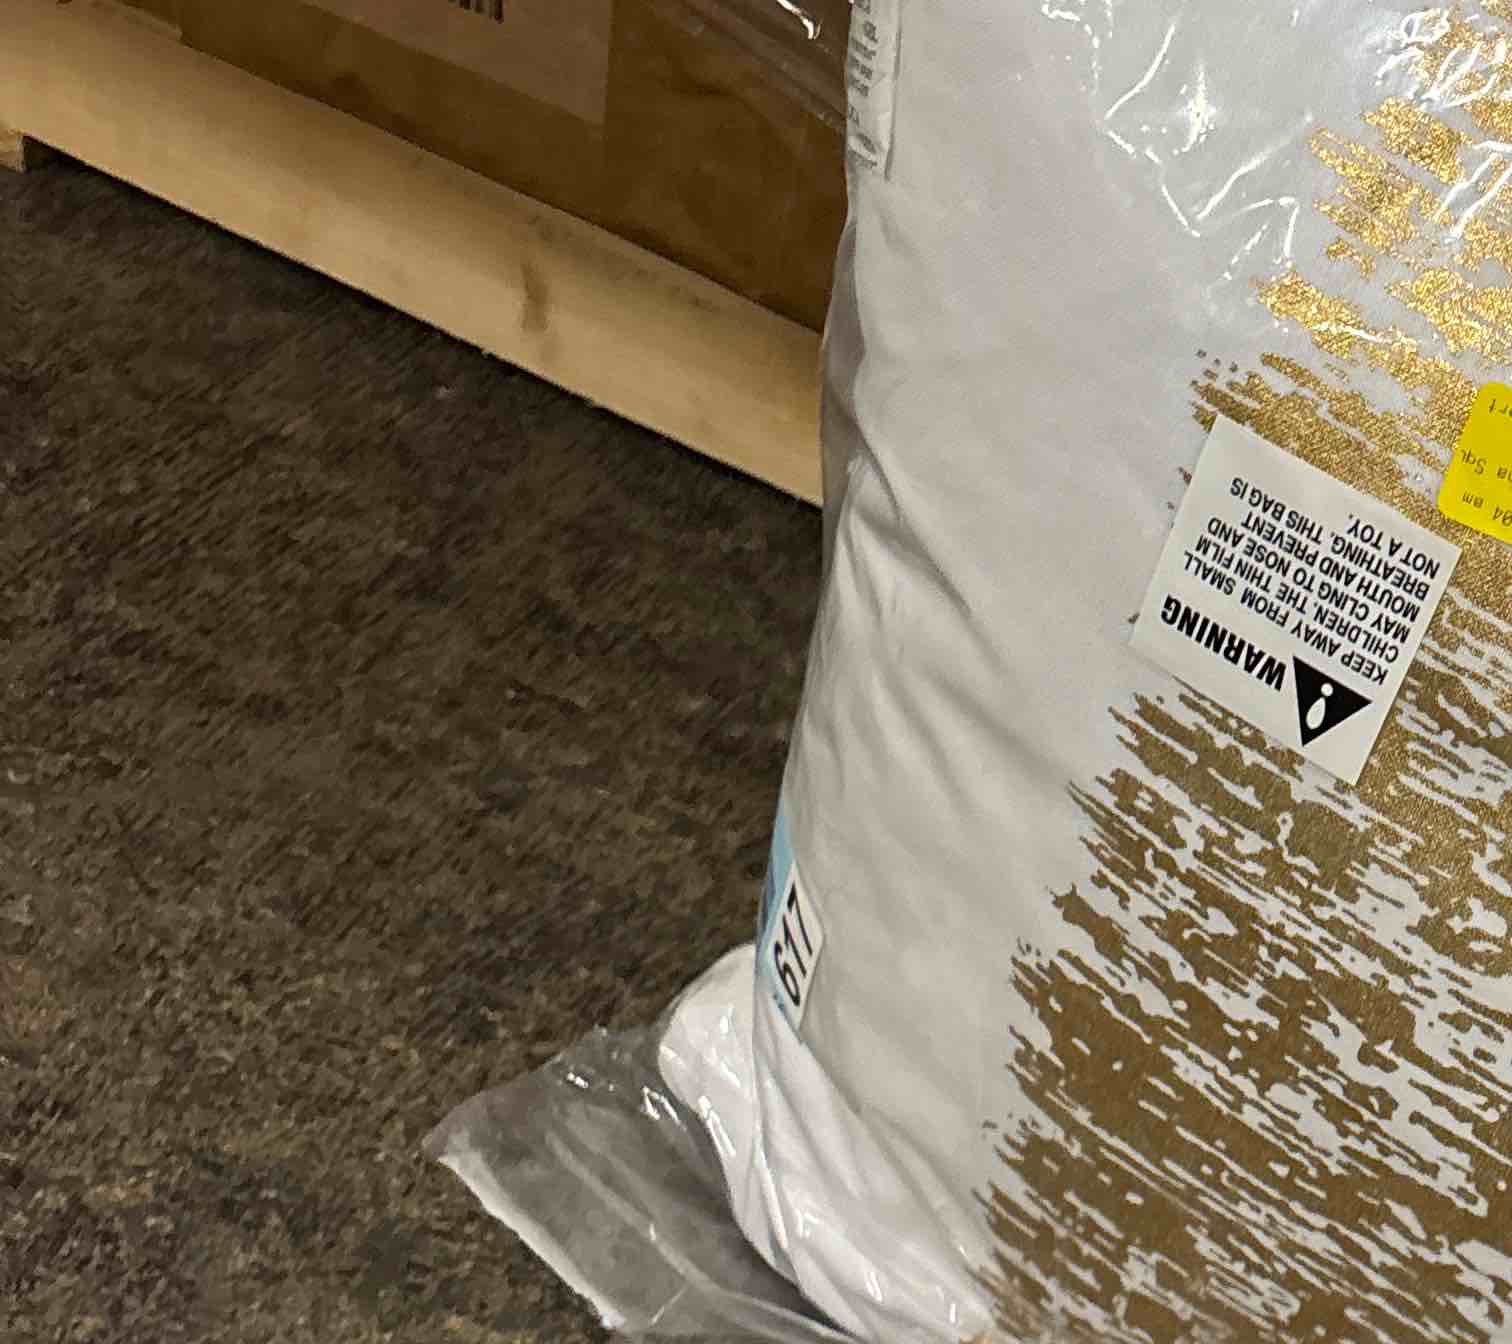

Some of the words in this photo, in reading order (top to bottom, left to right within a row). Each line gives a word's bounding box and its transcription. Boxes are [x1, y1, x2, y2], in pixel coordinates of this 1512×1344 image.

[1231, 478, 1249, 500] IS
[1249, 488, 1286, 522] BAG
[1461, 492, 1485, 510] am
[1208, 518, 1245, 548] AND
[1242, 512, 1319, 567] PREVENT
[1286, 511, 1323, 545] THIS
[1345, 514, 1384, 552] TOY.
[1196, 536, 1235, 570] FILM
[1244, 538, 1291, 577] NOSE
[1389, 538, 1403, 557] A
[1400, 548, 1440, 580] NOT
[1185, 552, 1236, 596] SMALL
[1234, 559, 1272, 593] THIN
[1293, 568, 1315, 593] TO
[1319, 557, 1358, 587] AND
[1328, 532, 1431, 602] BREATHING.
[1241, 588, 1290, 627] FROM
[1276, 583, 1308, 615] THE
[1318, 582, 1370, 622] CLING
[1356, 577, 1420, 622] MOUTH
[1160, 594, 1287, 691] WARNING
[1291, 621, 1341, 657] AWAY
[1311, 602, 1400, 664] CHILDREN.
[1371, 614, 1410, 644] MAY
[1341, 651, 1388, 685] KEEP
[774, 881, 813, 1006] 617
